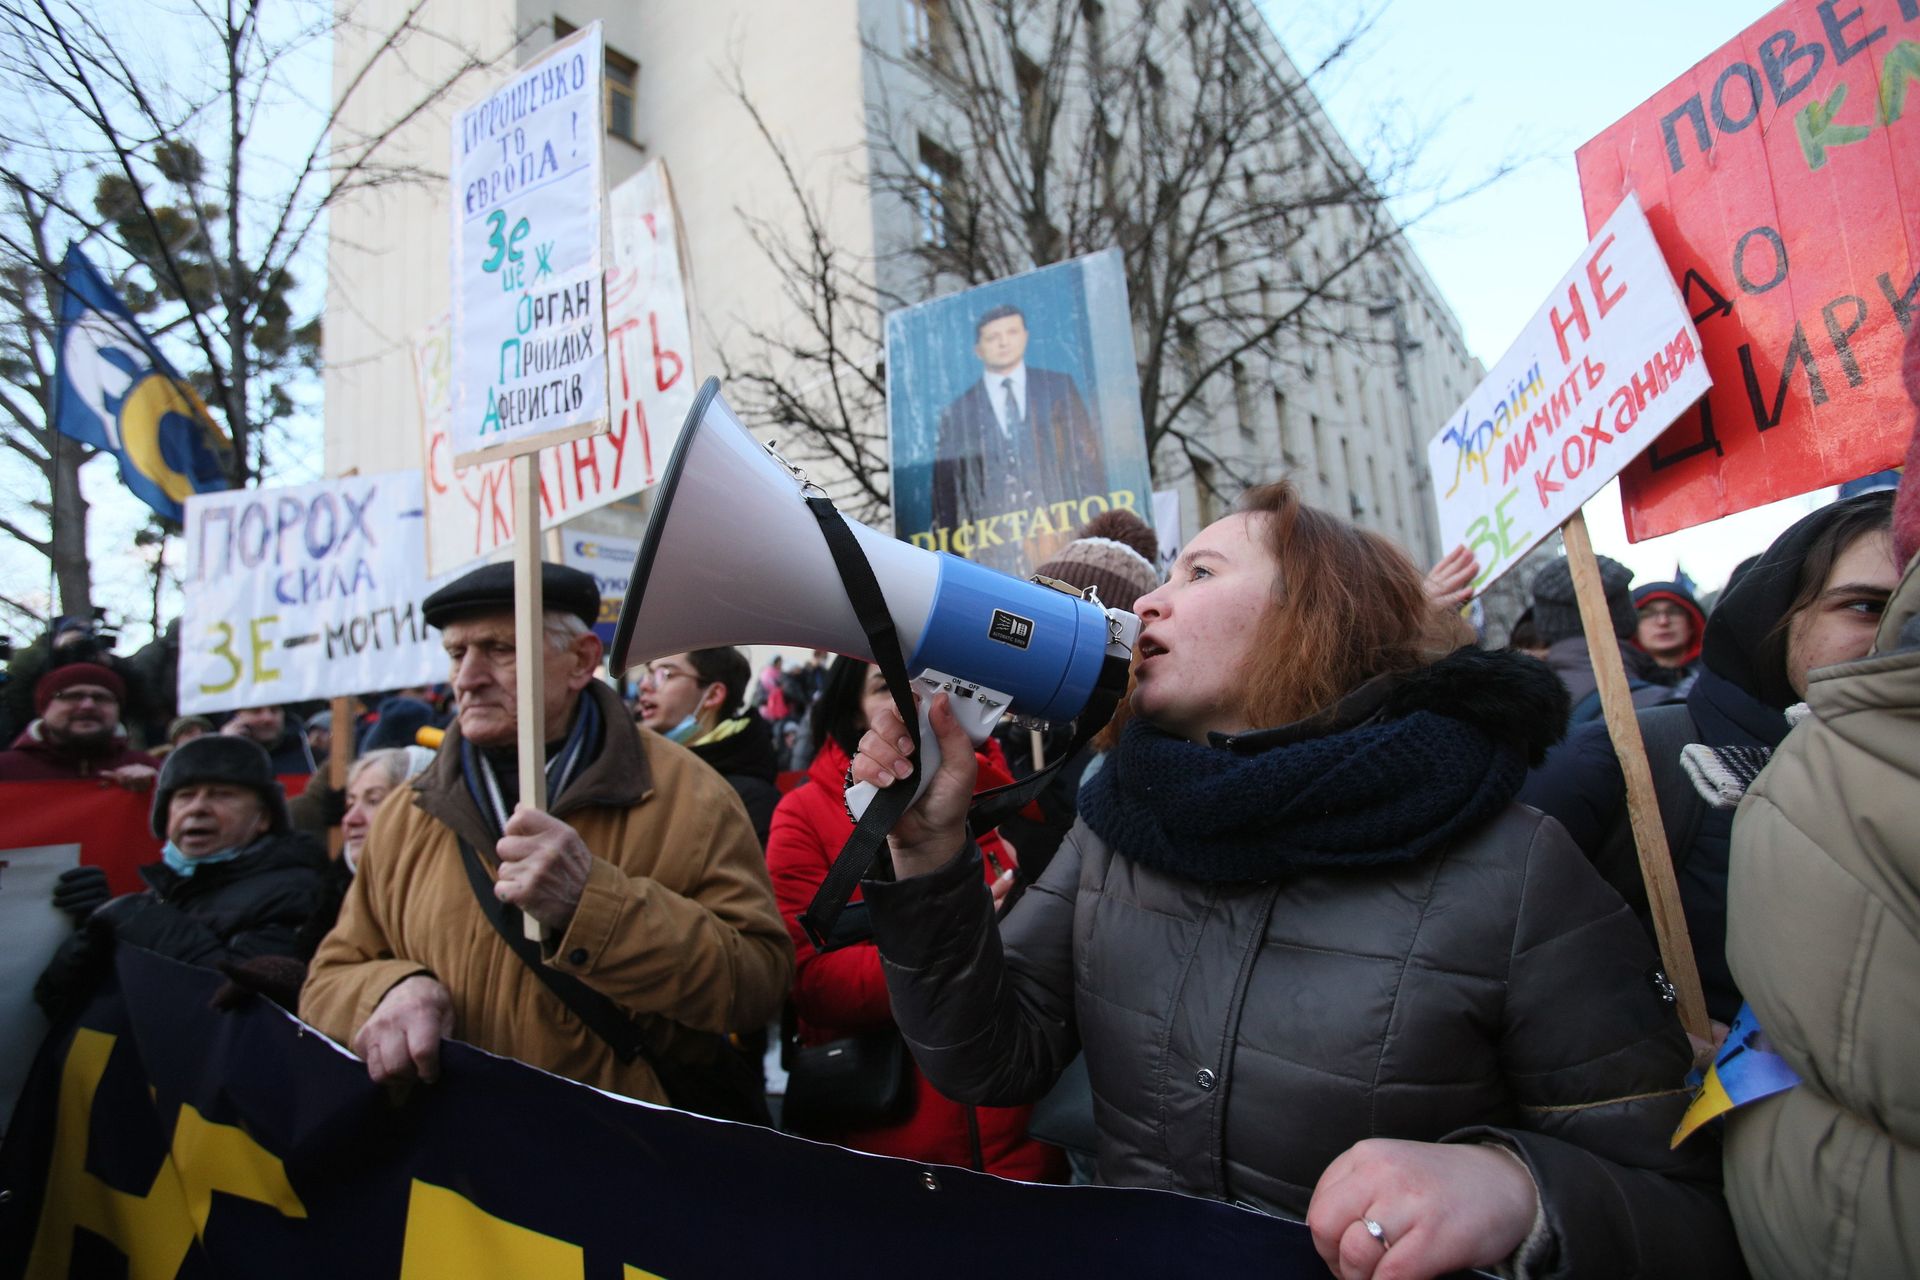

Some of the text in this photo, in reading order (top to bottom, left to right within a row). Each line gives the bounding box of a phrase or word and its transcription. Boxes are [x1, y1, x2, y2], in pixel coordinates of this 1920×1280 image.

[464, 53, 585, 155] ПОРОШЕНКО
[497, 127, 525, 163] ТО
[1549, 232, 1628, 366] НЕ
[199, 485, 376, 582] ПОРОХ
[274, 558, 376, 606] СИЛА
[952, 677, 962, 685] ON
[968, 683, 980, 691] OFF
